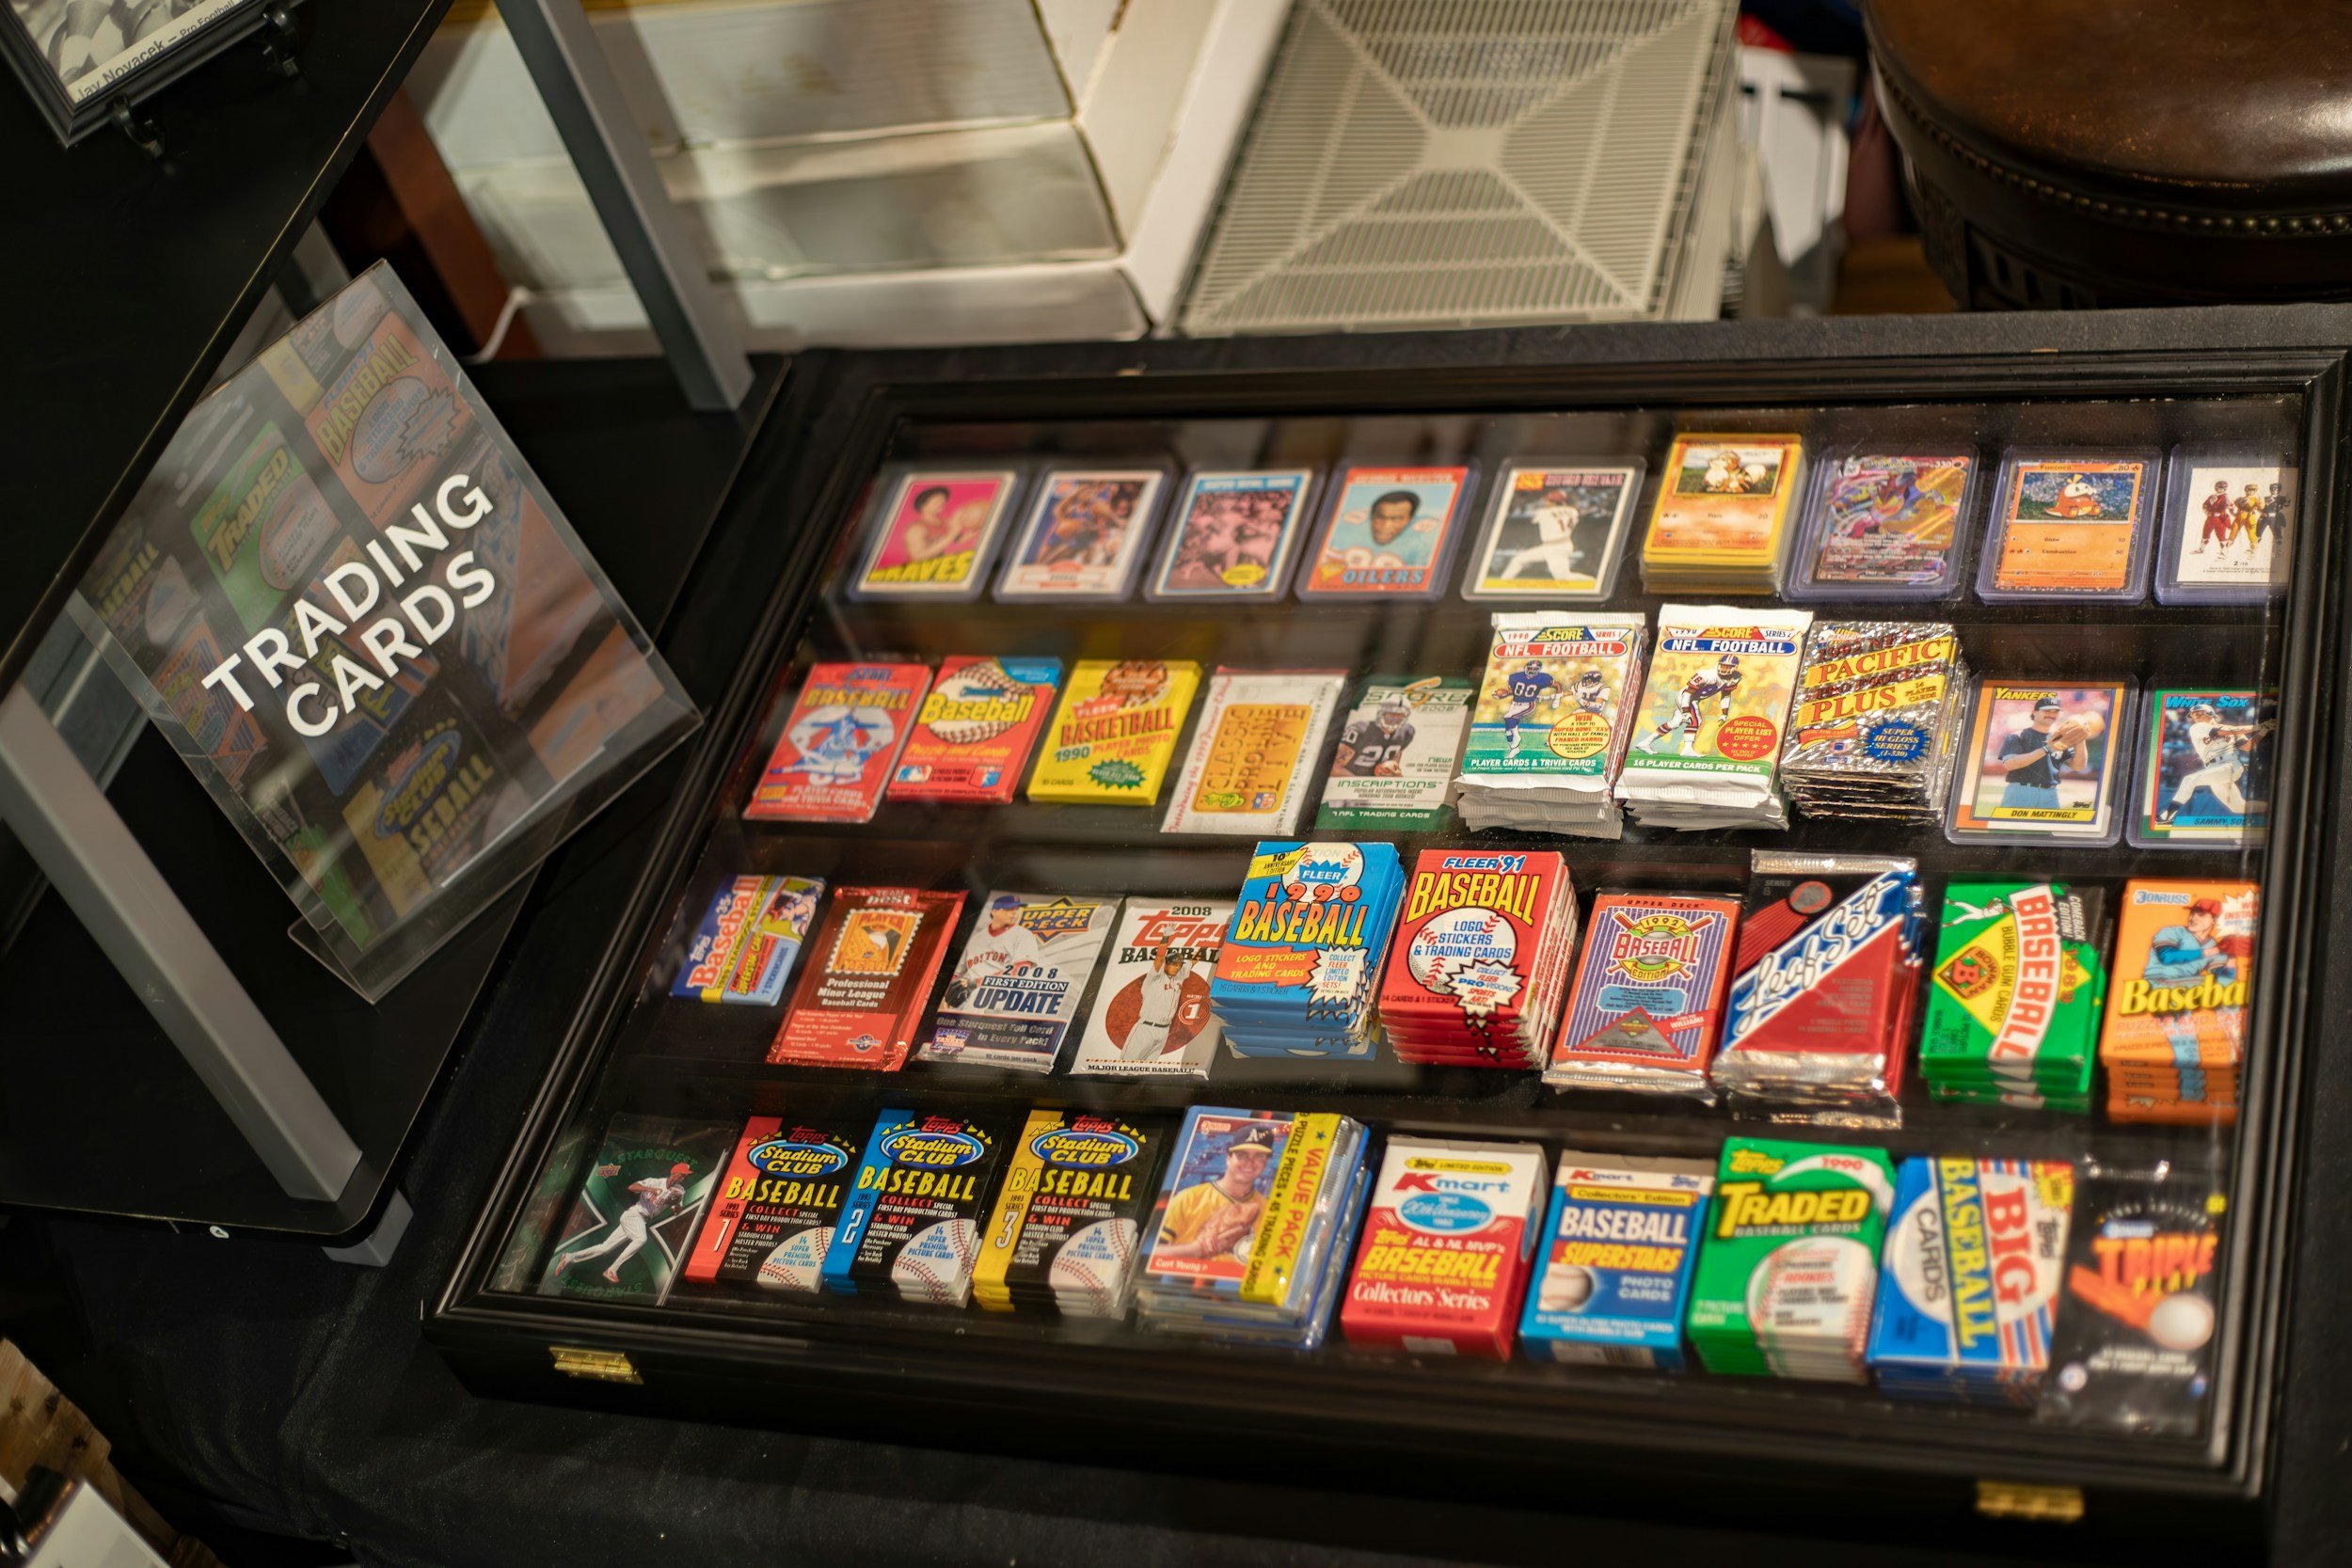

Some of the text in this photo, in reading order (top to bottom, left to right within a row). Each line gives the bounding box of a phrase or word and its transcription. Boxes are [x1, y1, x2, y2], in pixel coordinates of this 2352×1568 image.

[103, 40, 165, 83] Novacek
[198, 1, 235, 26] Football
[315, 333, 420, 467] BASEBALL
[206, 448, 291, 573] TRADED
[1343, 570, 1424, 584] OILERS
[201, 473, 494, 713] TRADING
[1546, 628, 1583, 641] SCORE
[1713, 627, 1753, 639] SCORE
[285, 549, 495, 737] CARDS
[1505, 643, 1614, 656] NFL FOOTBALL
[1672, 640, 1785, 653] NFL FOOTBALL
[1820, 640, 1941, 683] PACIFIC
[1994, 688, 2058, 700] YANKEES
[918, 693, 1036, 724] Baseball
[1812, 687, 1896, 721] PLUS
[2166, 696, 2248, 707] WHITE SOX
[1061, 706, 1174, 746] BASKETBALL
[1056, 746, 1090, 763] 1990
[2011, 810, 2076, 819] DON MATTINGLY
[1302, 870, 1341, 880] FLEER
[1266, 882, 1362, 902] 1990
[2135, 891, 2189, 904] DONRUSS
[1405, 872, 1541, 927] BASEBALL
[1024, 909, 1090, 920] UPPER
[1172, 907, 1211, 915] 2008
[2070, 895, 2086, 941] COMEBACK
[1234, 900, 1369, 945] BASEBALL
[1454, 922, 1483, 931] LOGO
[1646, 918, 1678, 927] 1992
[686, 875, 764, 988] Baseball
[1438, 933, 1493, 944] STICKERS
[1414, 946, 1511, 958] & TRADING CARDS
[1613, 934, 1699, 963] BASEBALL
[1236, 954, 1261, 962] LOGO
[1003, 965, 1058, 979] 2008
[1231, 970, 1271, 978] TRADING
[1632, 970, 1666, 978] EDITION
[1991, 926, 2016, 1022] BUBBLE GUM CARDS
[1994, 895, 2055, 1059] BASEBALL
[827, 978, 889, 989] Professional
[984, 976, 1067, 990] FIRST EDITION
[1736, 935, 1820, 1035] Leaf
[818, 988, 885, 999] Minor League
[1468, 988, 1496, 997] SPORTS
[974, 989, 1065, 1014] UPDATE
[937, 1017, 1007, 1032] One Starquest
[991, 1034, 1017, 1045] Every
[893, 1136, 973, 1154] Stadium
[1043, 1136, 1126, 1153] Stadium
[760, 1147, 838, 1163] Stadium
[899, 1151, 958, 1165] CLUB
[1051, 1150, 1111, 1164] CLUB
[767, 1161, 823, 1174] CLUB
[857, 1166, 976, 1200] BASEBALL
[1009, 1168, 1132, 1199] BASEBALL
[1393, 1173, 1510, 1192] Kmart
[725, 1177, 839, 1208] BASEBALL
[1645, 1194, 1685, 1203] Edition
[881, 1196, 934, 1207] COLLECT
[1035, 1196, 1089, 1207] COLLECT
[1275, 1148, 1324, 1259] VALUE PACK
[750, 1205, 800, 1216] COLLECT
[903, 1207, 937, 1215] PRODUCTION
[1717, 1181, 1869, 1237] TRADED
[888, 1216, 914, 1225] WIN
[1043, 1215, 1071, 1225] WIN
[1559, 1207, 1688, 1243] BASEBALL
[996, 1211, 1019, 1248] 3
[1735, 1224, 1860, 1237] BASEBALL CARDS
[1986, 1187, 2035, 1304] BIG
[1561, 1242, 1682, 1273] SUPERSTARS
[1916, 1209, 1945, 1301] CARDS
[1940, 1160, 1994, 1347] BASEBALL
[1156, 1259, 1175, 1268] Curt
[1361, 1246, 1501, 1280] BASEBALL
[1621, 1275, 1673, 1288] PHOTO
[1438, 1289, 1490, 1309] Series
[1619, 1289, 1671, 1301] CARDS
